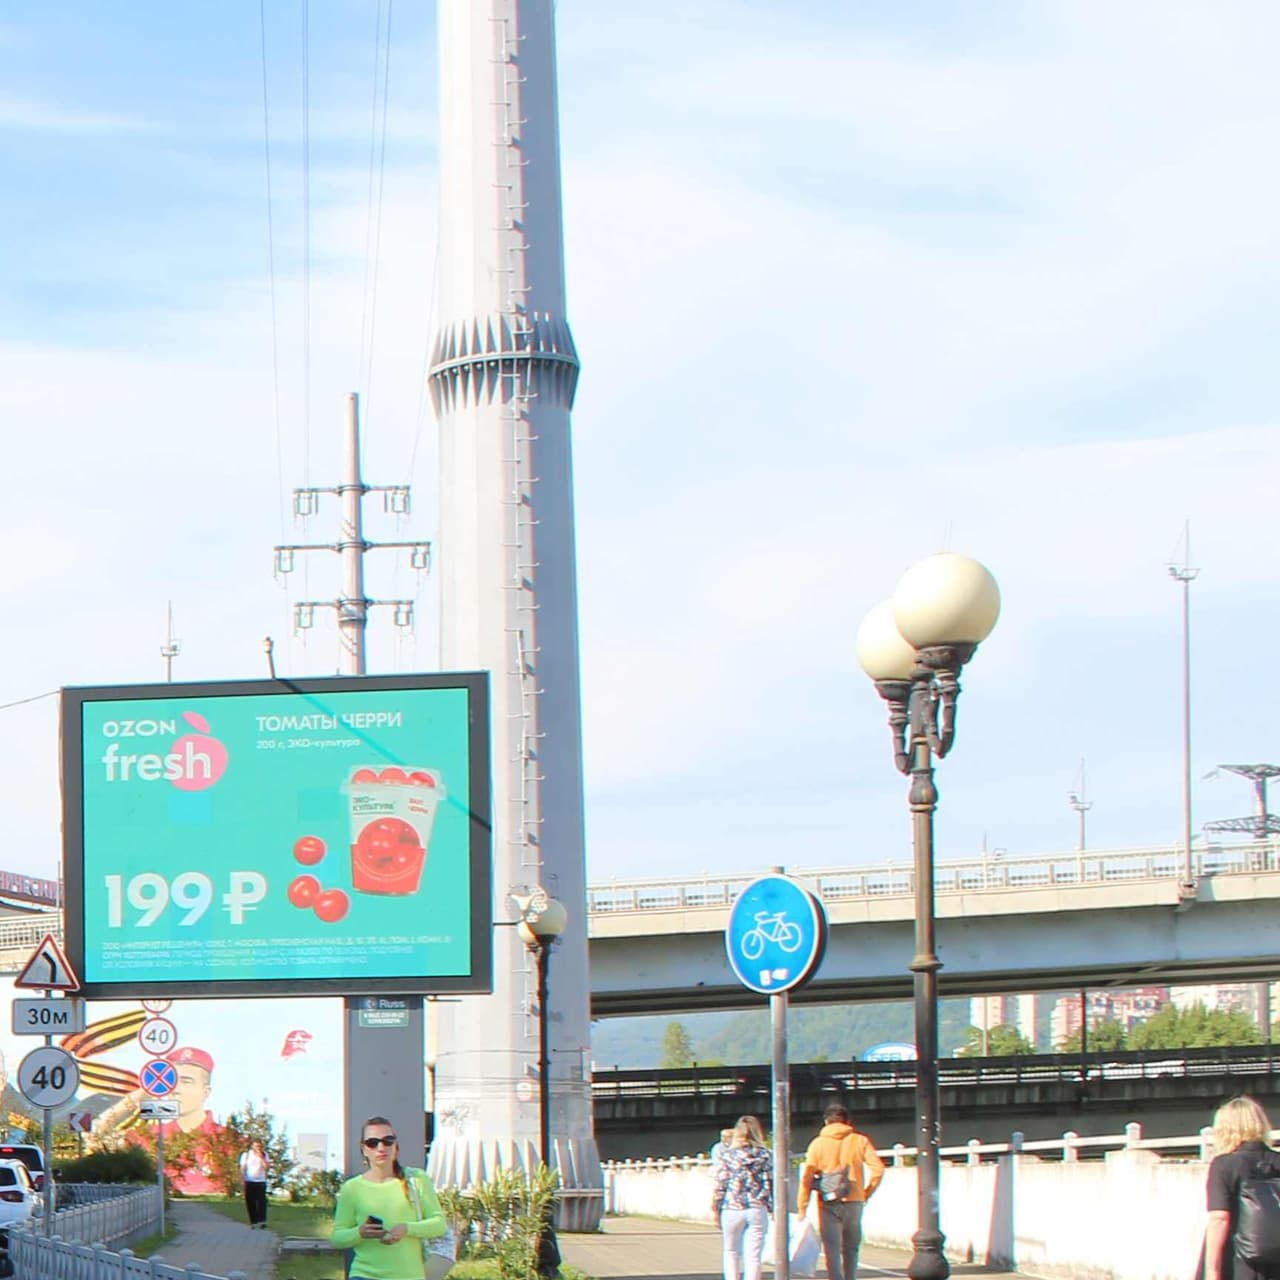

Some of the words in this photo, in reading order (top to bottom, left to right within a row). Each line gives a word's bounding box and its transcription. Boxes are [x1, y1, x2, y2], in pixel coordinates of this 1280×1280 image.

[102, 719, 177, 738] OZON
[255, 714, 337, 732] ТОМАТЫ
[341, 711, 402, 729] ЧЕРРИ
[101, 741, 212, 782] fresh
[104, 871, 214, 928] 199
[222, 871, 268, 925] ₽
[146, 1029, 170, 1045] 40
[32, 1066, 66, 1090] 40
